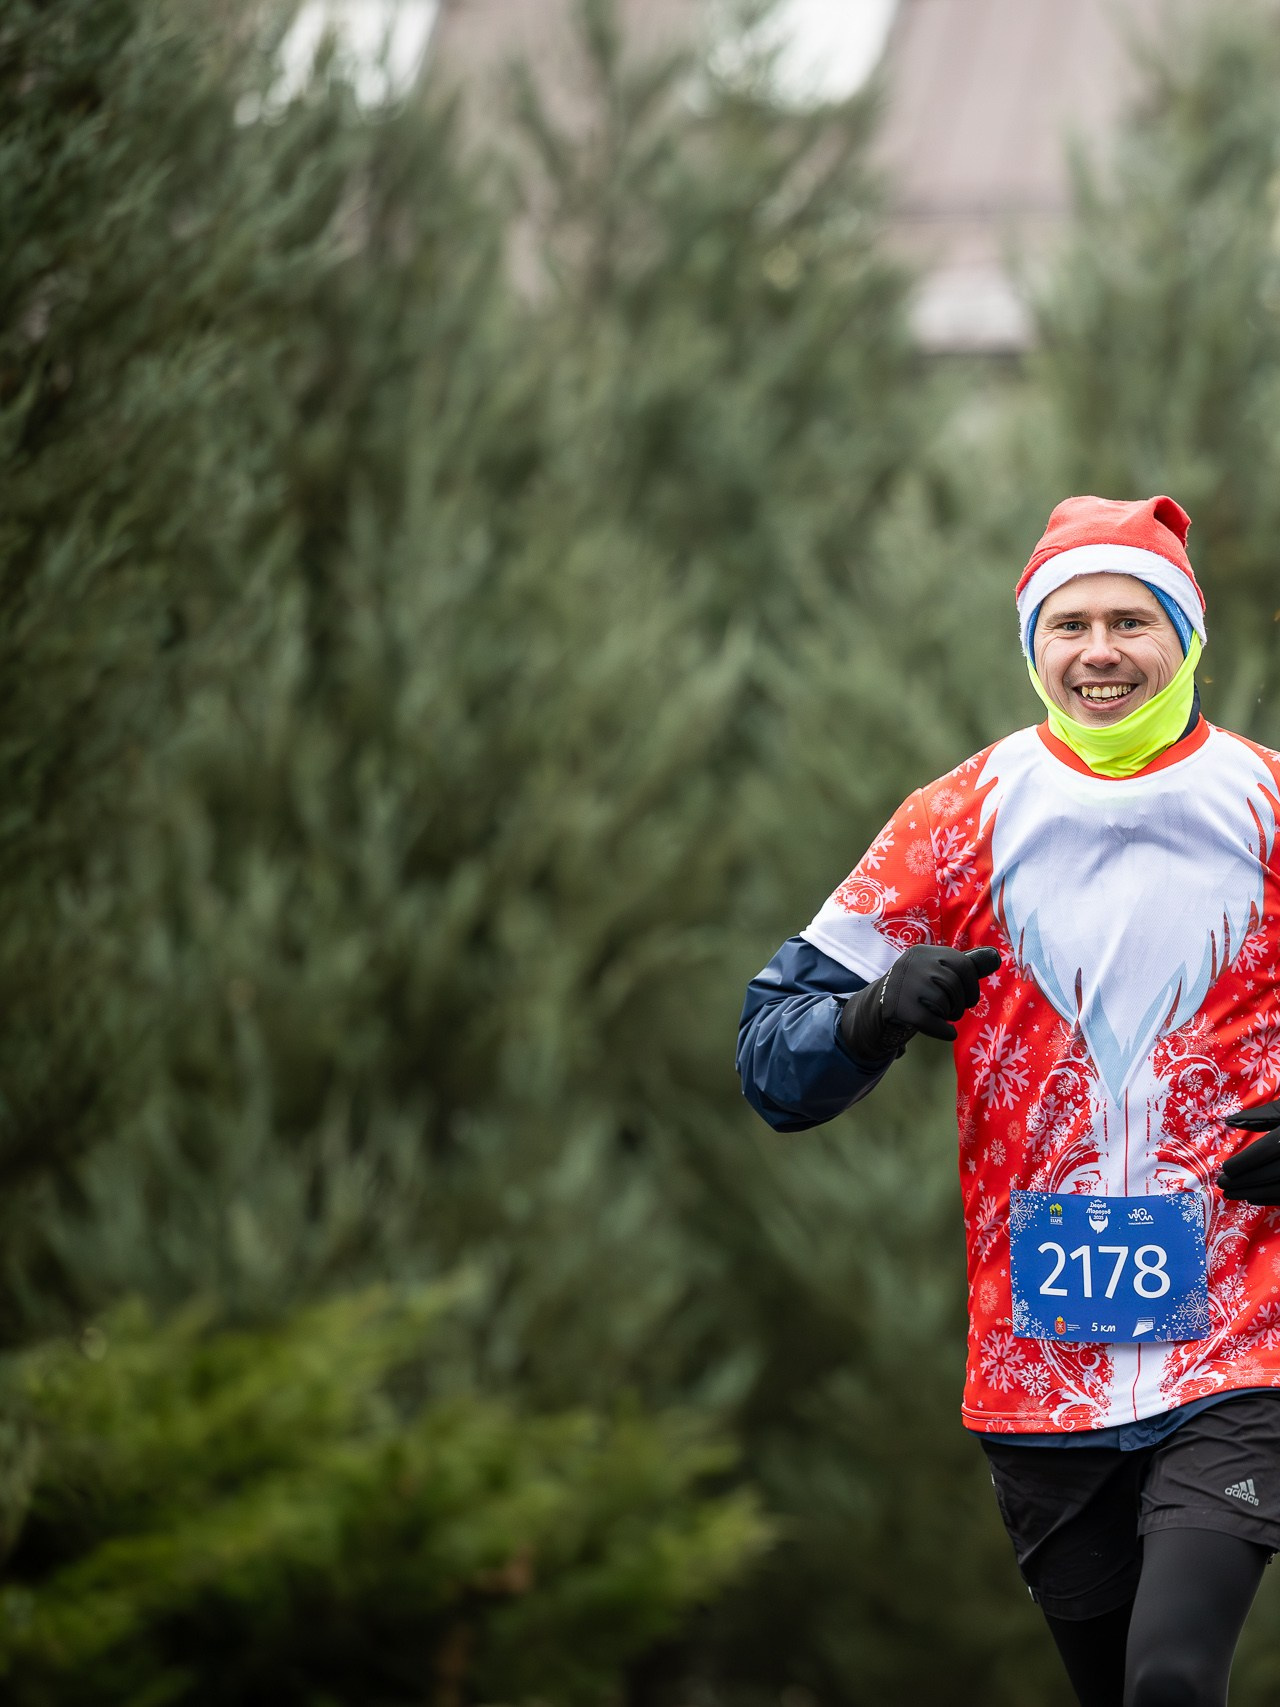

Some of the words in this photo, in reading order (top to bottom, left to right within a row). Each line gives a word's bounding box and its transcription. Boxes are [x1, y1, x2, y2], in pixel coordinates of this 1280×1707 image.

[1037, 1241, 1171, 1299] 2178
[1091, 1322, 1099, 1332] 5
[1224, 1487, 1259, 1506] adidas
